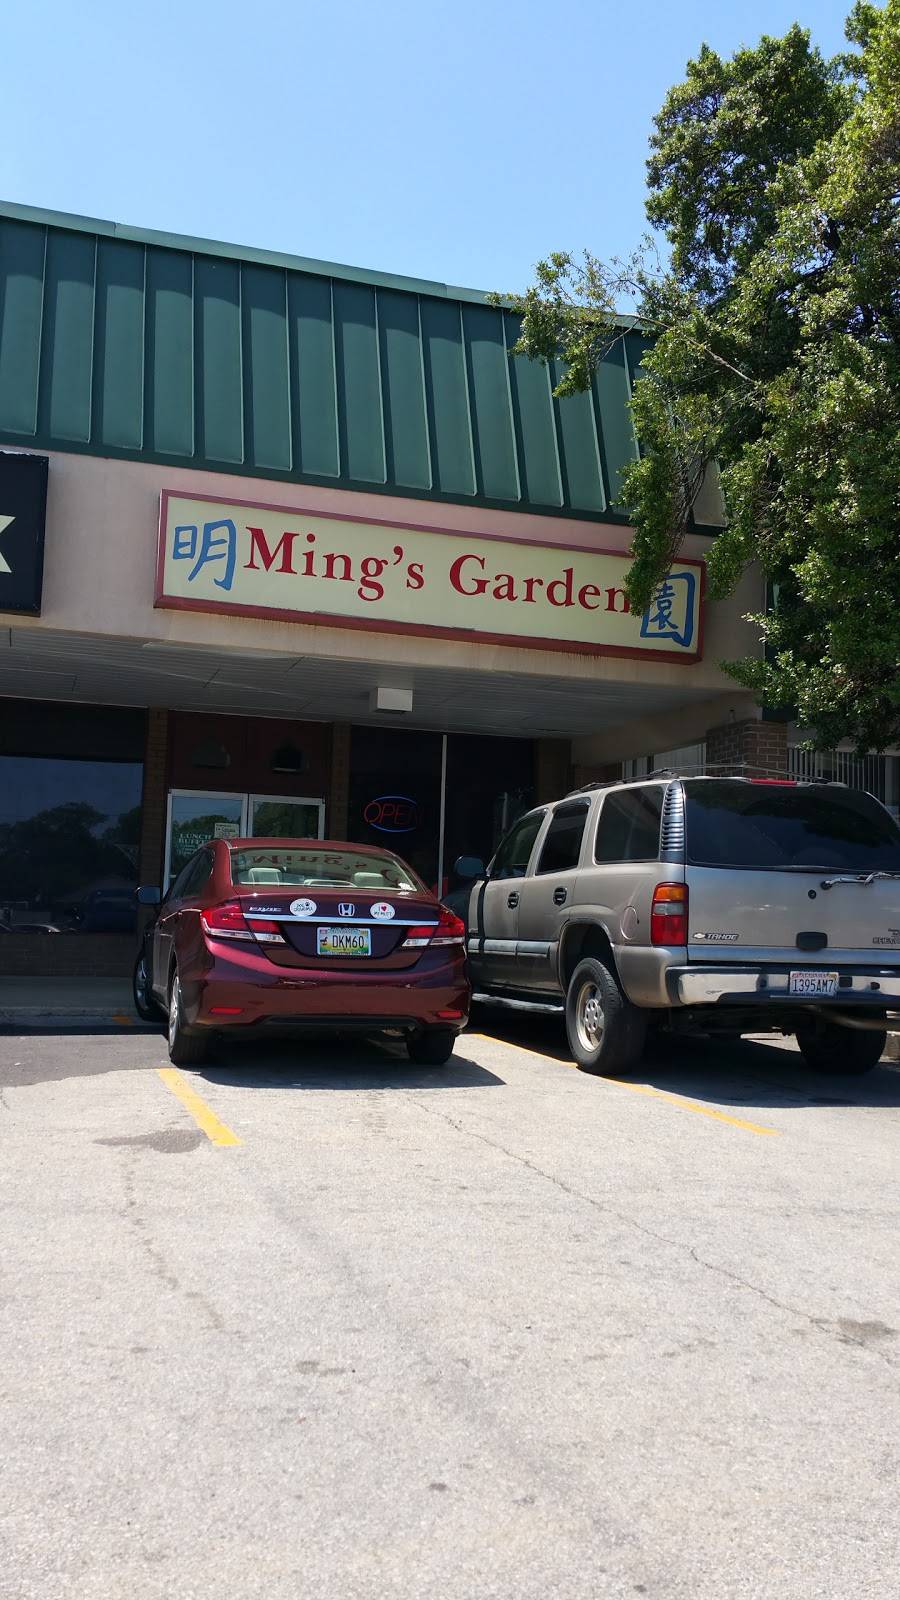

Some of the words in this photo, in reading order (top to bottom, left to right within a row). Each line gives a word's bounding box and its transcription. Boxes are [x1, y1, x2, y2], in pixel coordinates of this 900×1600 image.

[172, 519, 237, 591] 明
[243, 526, 425, 601] Ming's
[449, 554, 632, 613] Garden
[332, 935, 364, 949] DKM60
[792, 978, 834, 992] 1395AM7
